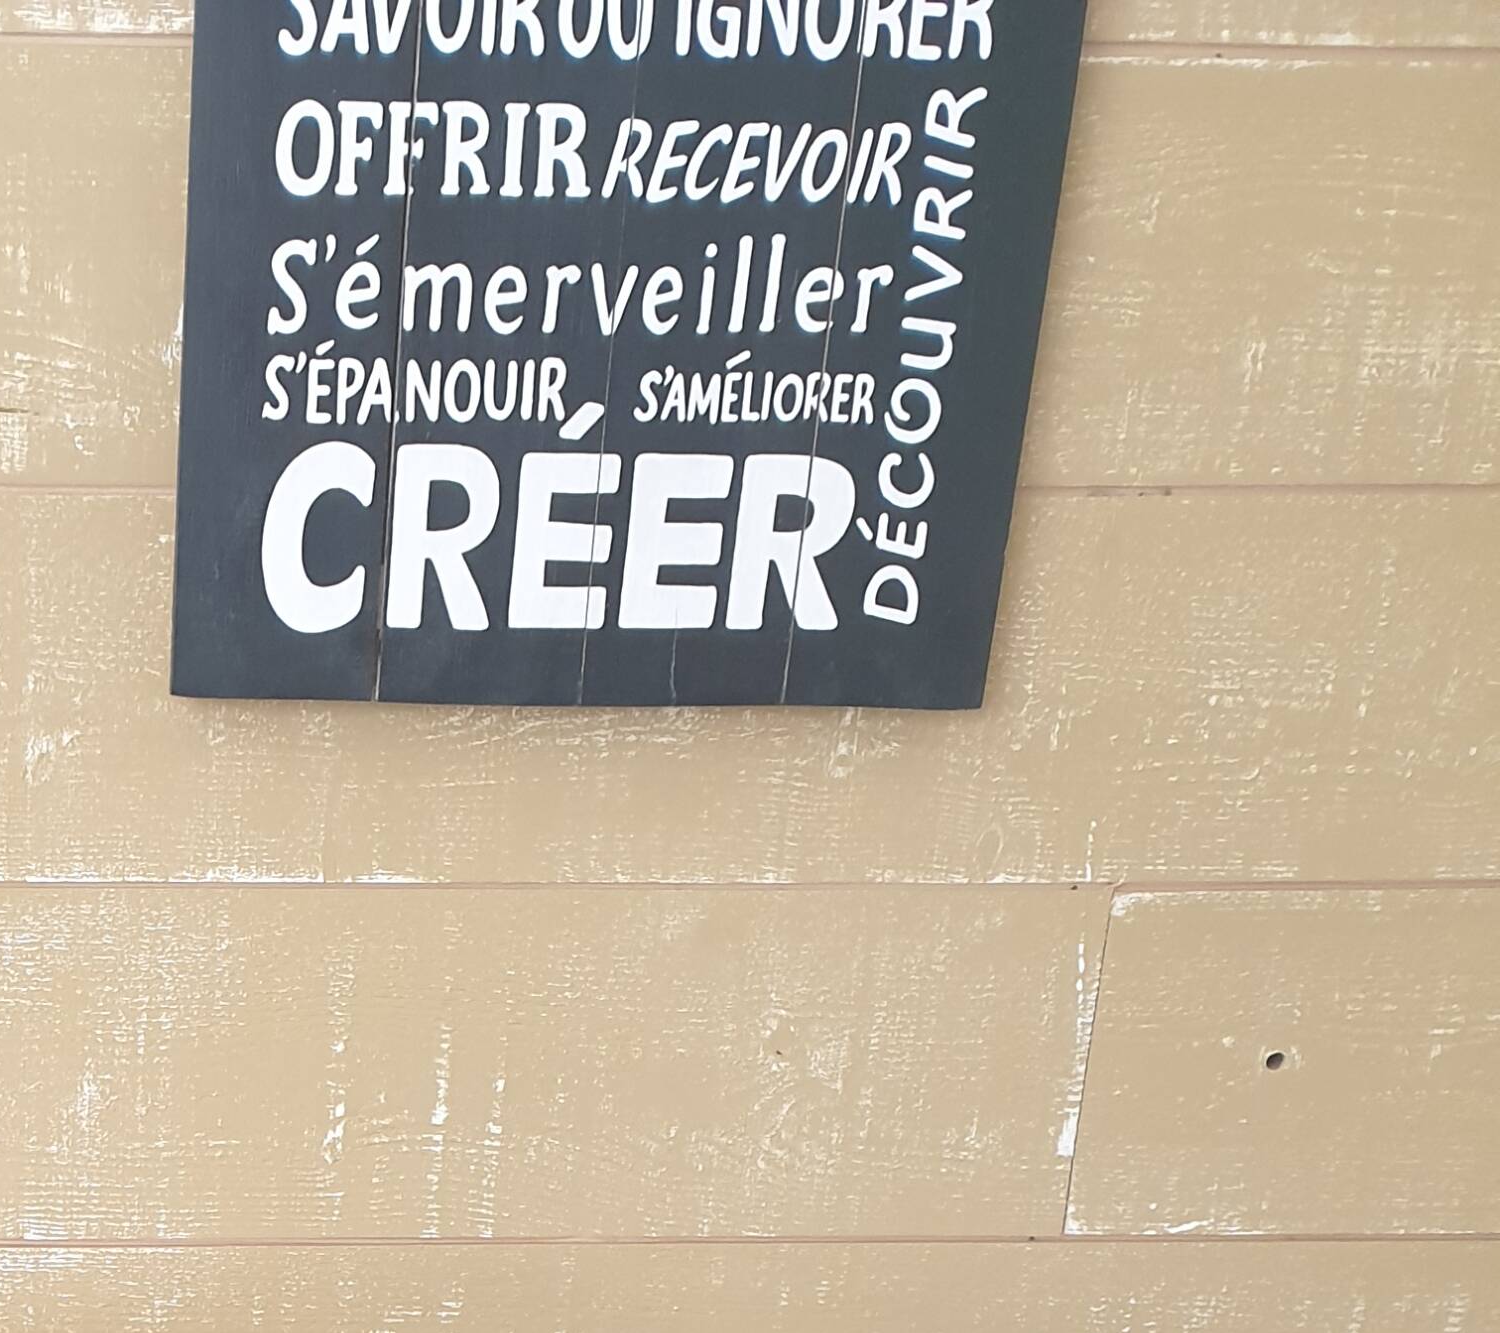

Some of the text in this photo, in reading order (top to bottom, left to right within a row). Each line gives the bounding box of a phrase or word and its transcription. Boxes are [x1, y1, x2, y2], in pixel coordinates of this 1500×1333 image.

[276, 99, 912, 205] OFFRIR RECEVOIR
[267, 234, 894, 336] S'émerveiller
[262, 340, 875, 425] S'ÉPANOUIR S'AMÉLIORER
[855, 87, 988, 625] DÉCOUVRIR
[262, 402, 856, 633] CRÉER
